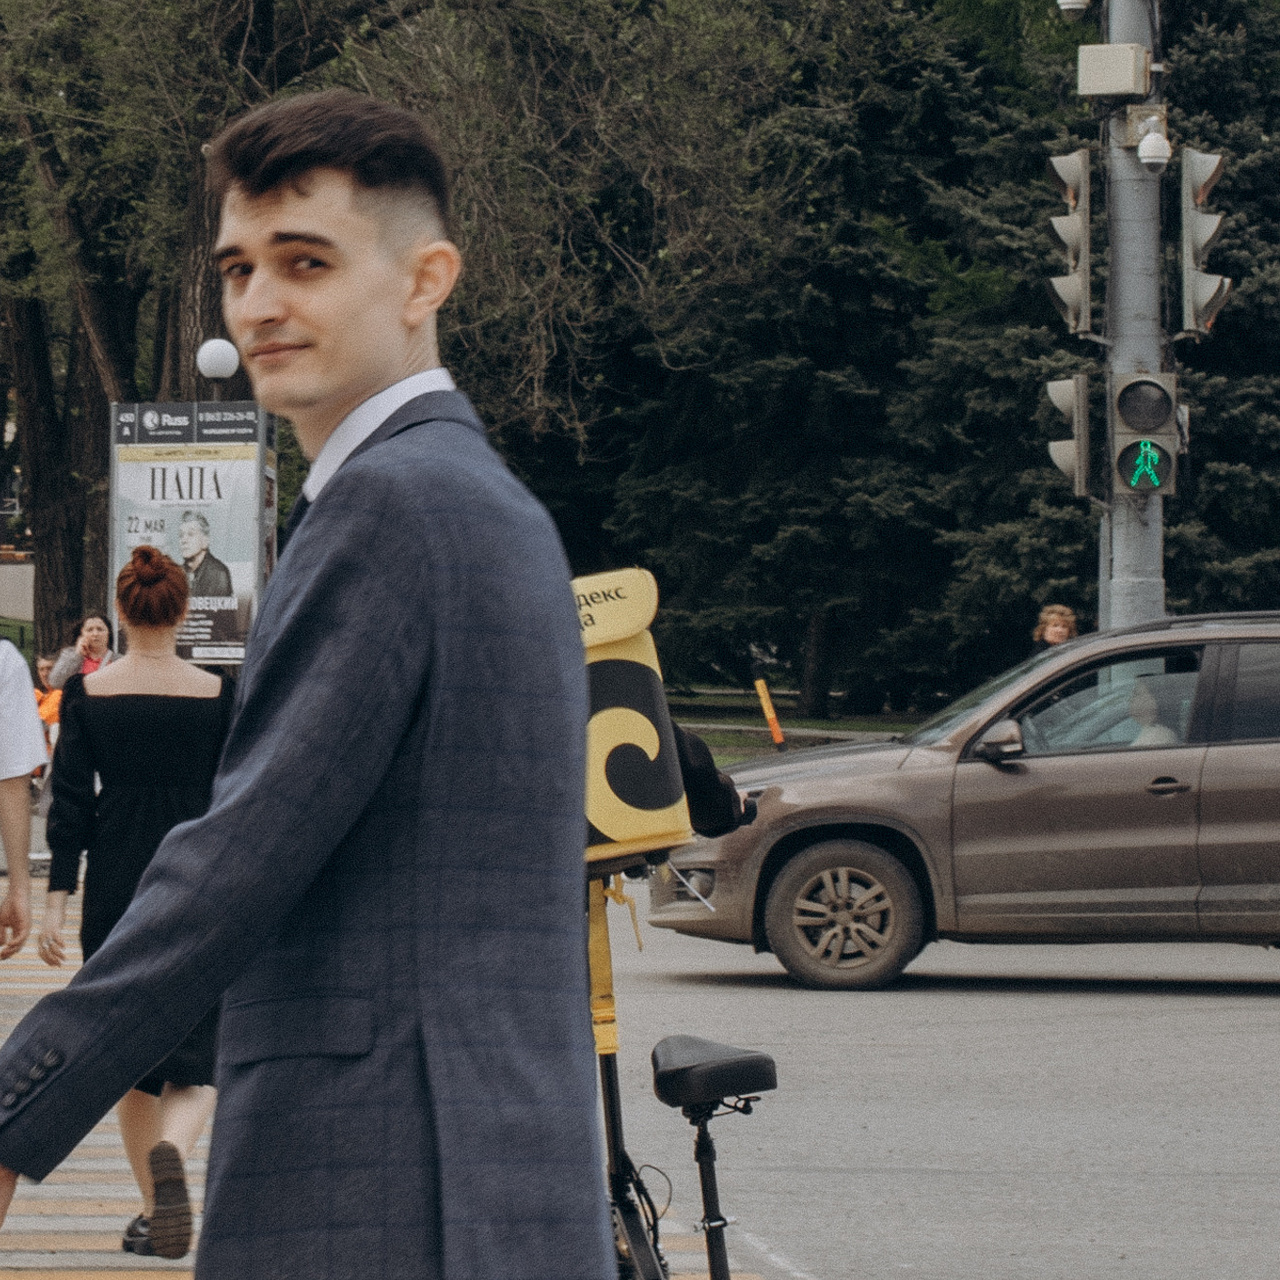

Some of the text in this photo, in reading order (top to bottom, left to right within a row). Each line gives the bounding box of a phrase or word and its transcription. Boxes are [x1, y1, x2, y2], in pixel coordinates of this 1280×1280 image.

[148, 466, 223, 501] ПАПА
[127, 516, 140, 533] 22
[188, 596, 239, 613] ОВЕЦКИЙ
[576, 587, 628, 611] декс
